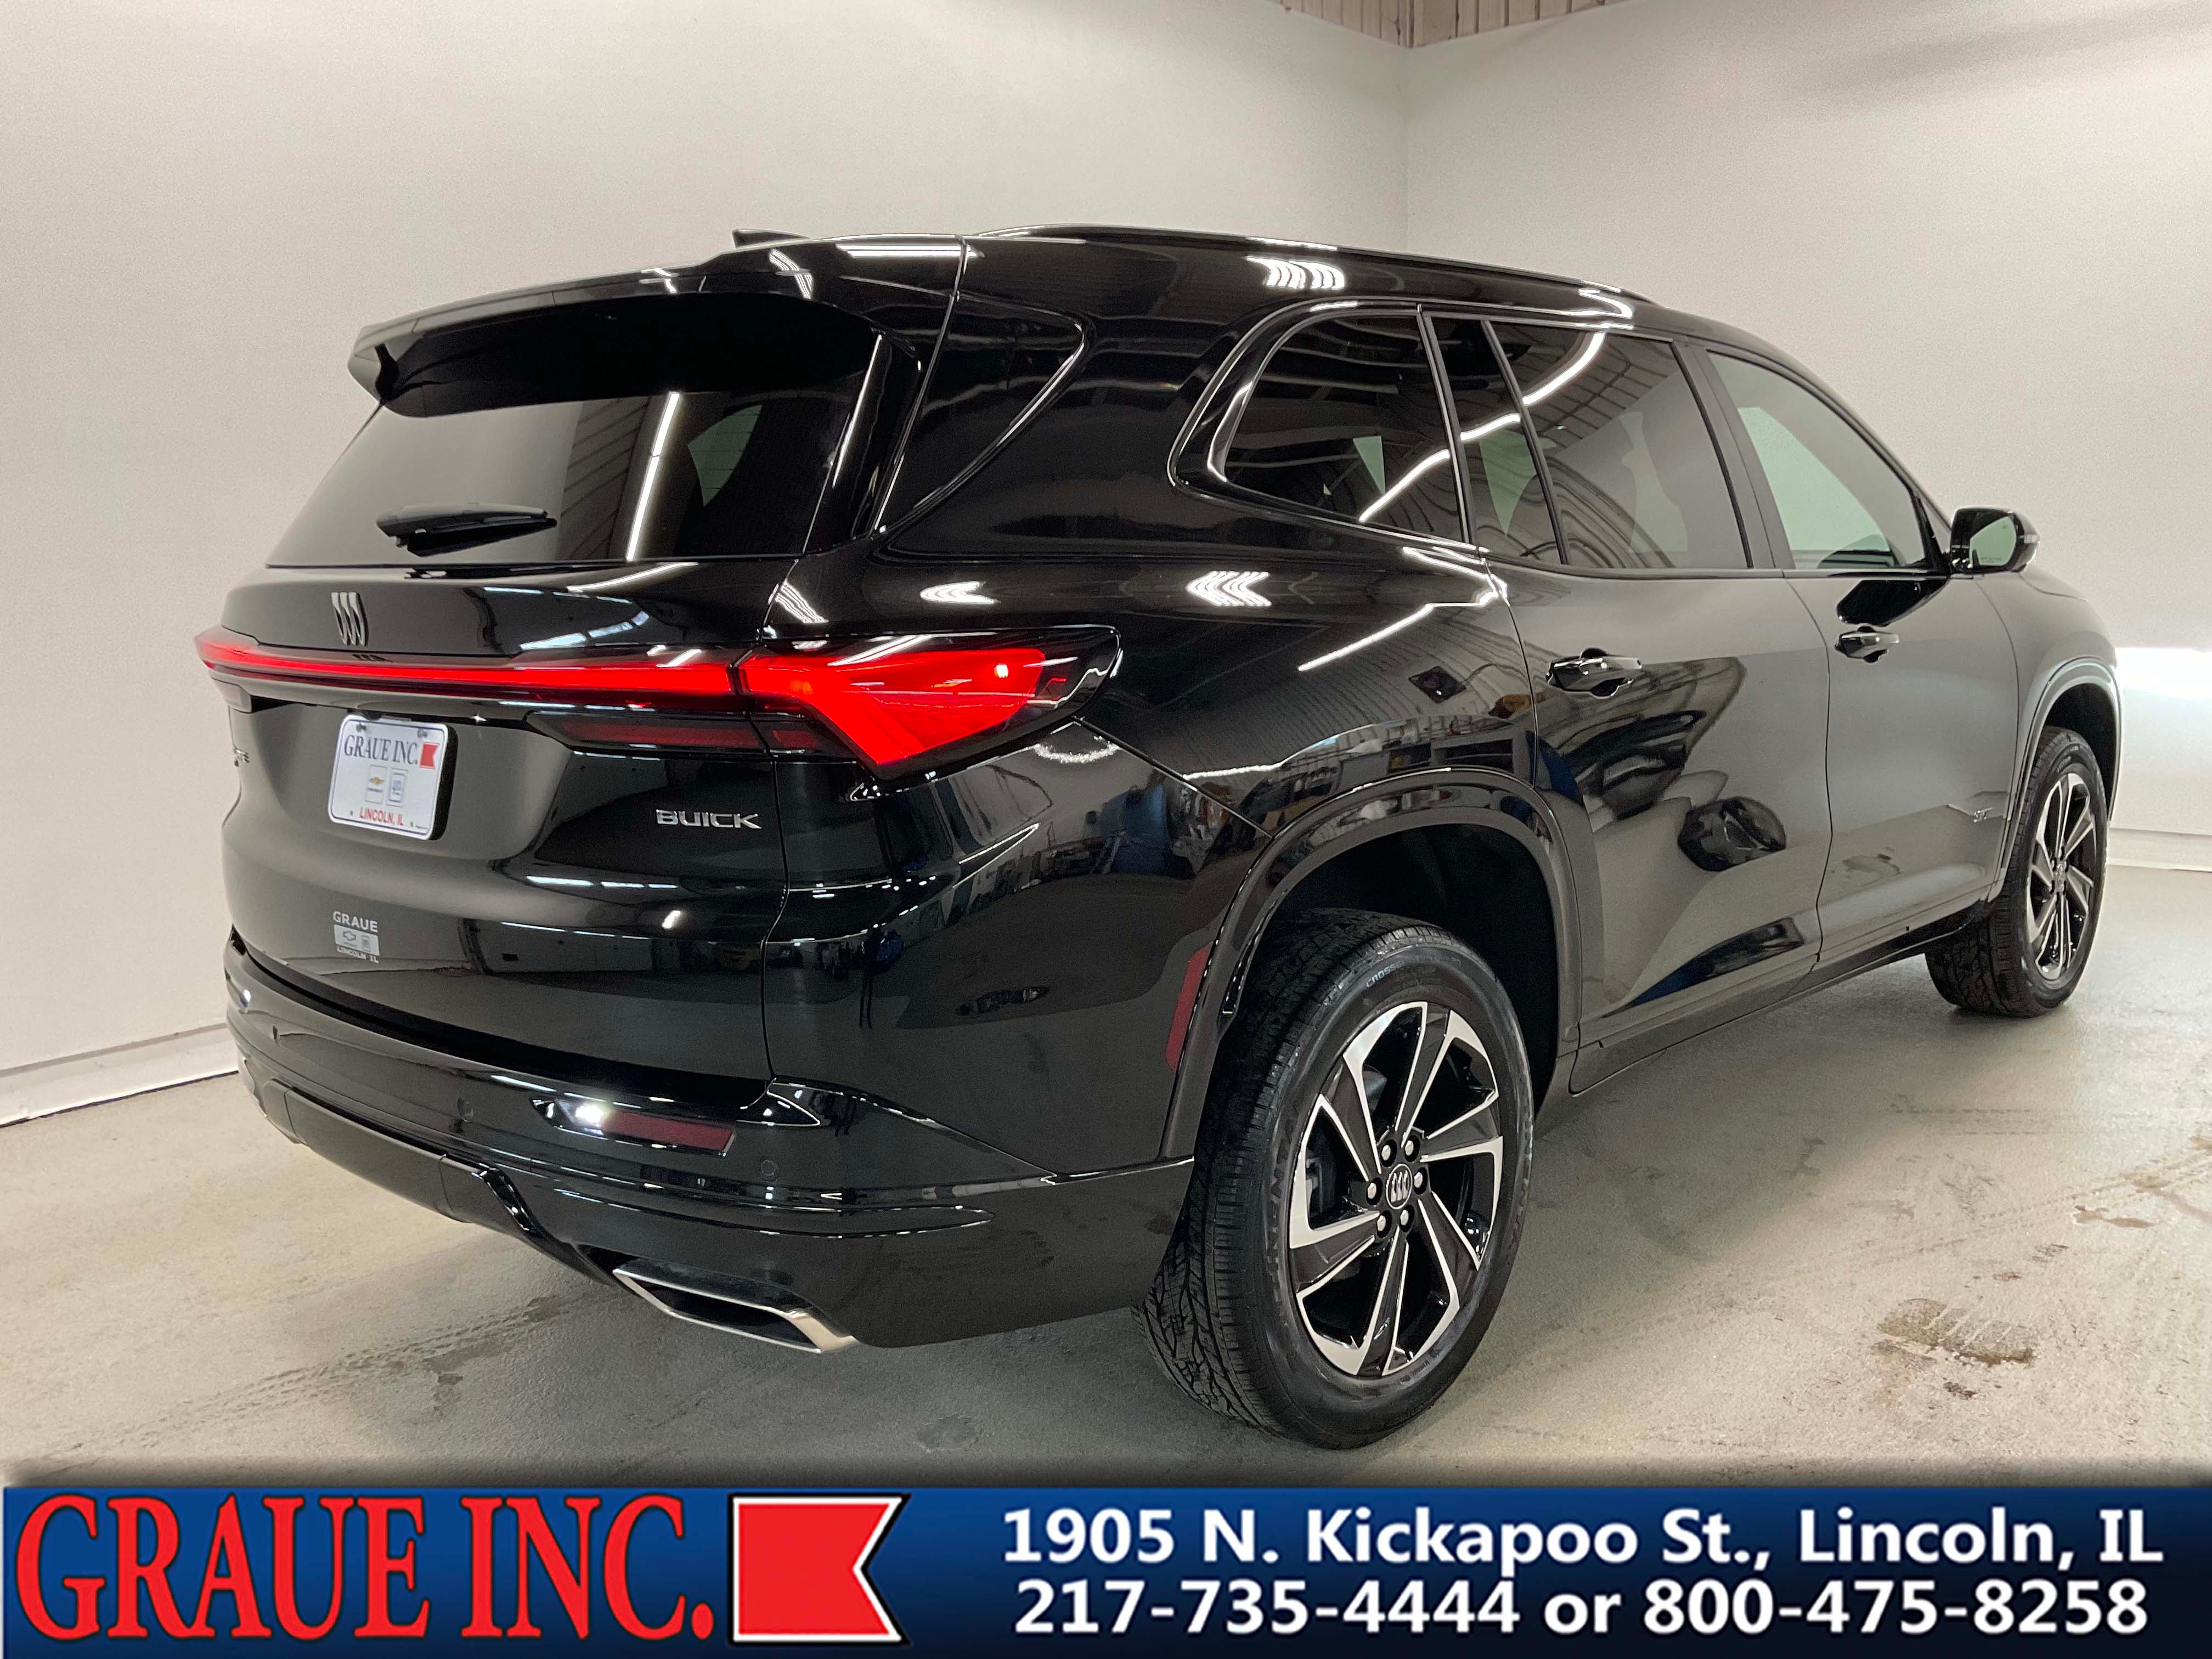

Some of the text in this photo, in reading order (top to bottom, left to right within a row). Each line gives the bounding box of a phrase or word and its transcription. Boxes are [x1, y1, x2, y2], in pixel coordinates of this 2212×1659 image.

[344, 735, 419, 765] GRAUE INC.
[359, 807, 404, 826] LINCOLN, IL
[655, 809, 762, 830] BUICK
[332, 911, 378, 933] GRAUE
